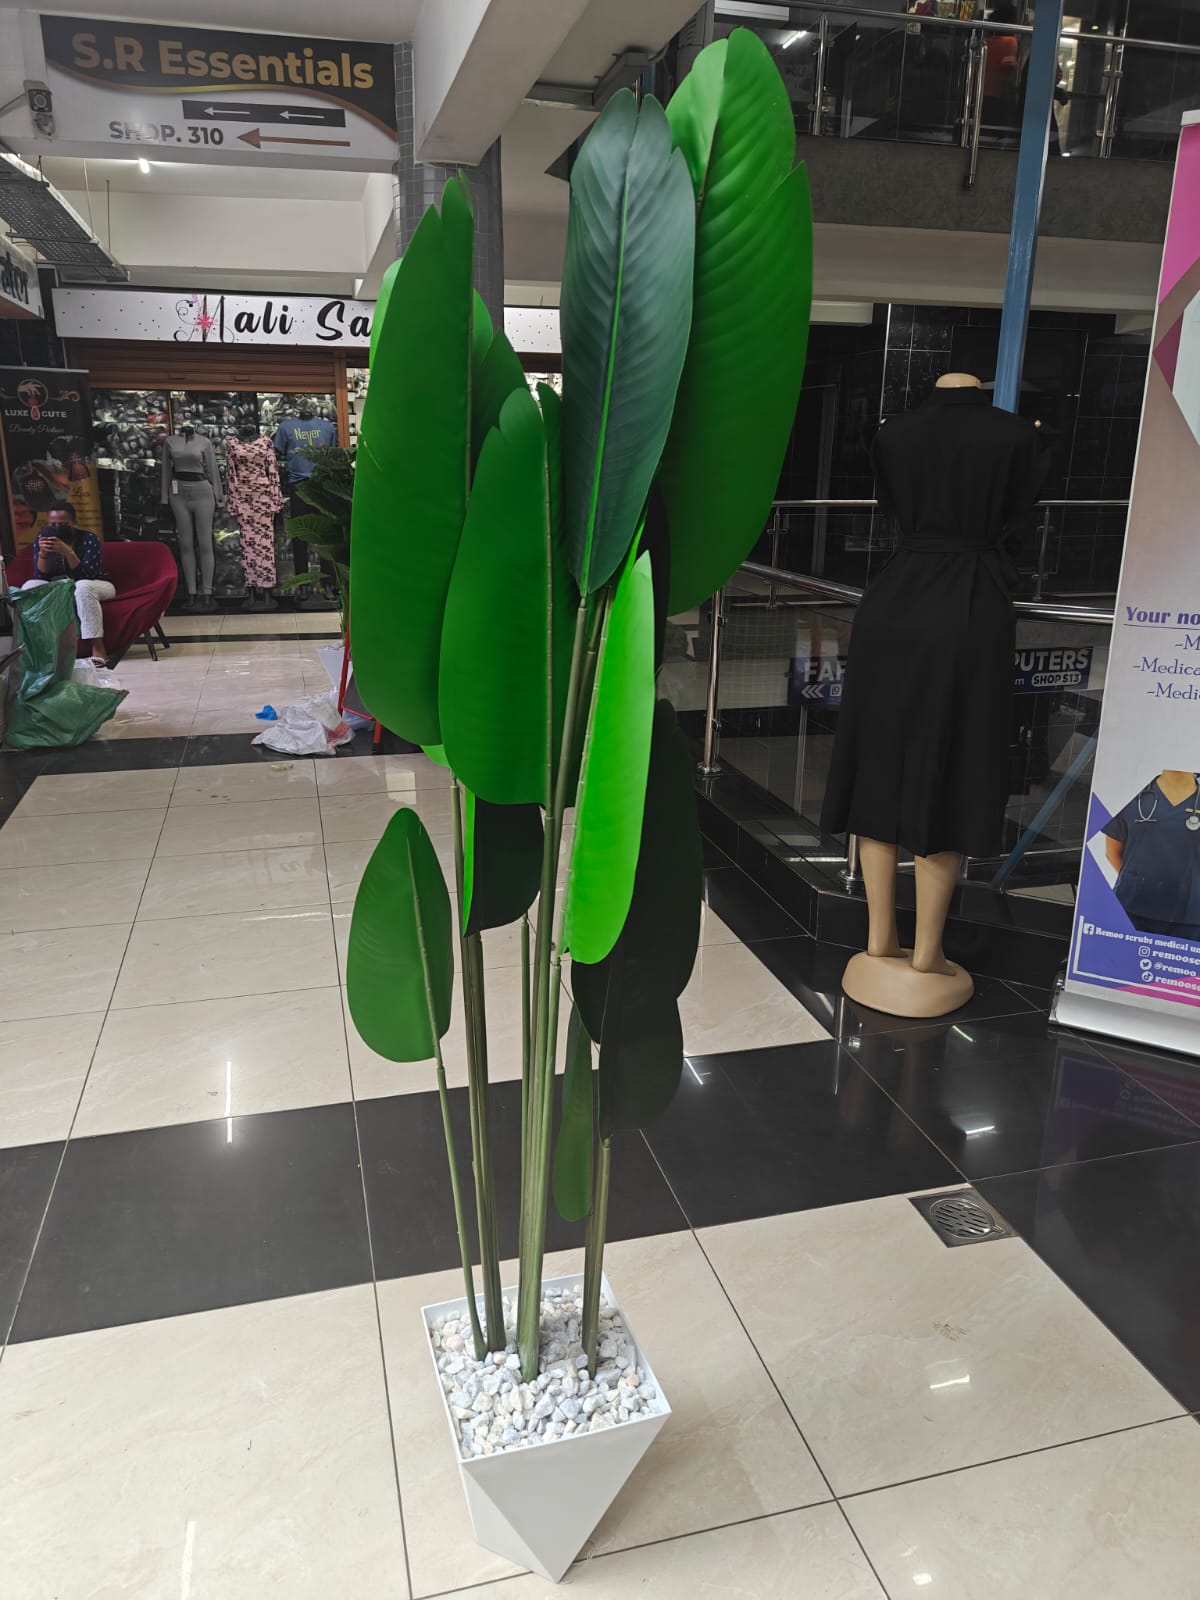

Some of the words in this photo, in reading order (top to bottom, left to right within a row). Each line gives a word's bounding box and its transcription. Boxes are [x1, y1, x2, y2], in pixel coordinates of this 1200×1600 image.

[72, 32, 145, 72] S.R
[158, 39, 374, 89] Essentials
[187, 126, 224, 145] 310
[4, 409, 29, 417] LUXE
[1125, 606, 1171, 624] Your
[1014, 648, 1089, 672] UTERS
[1033, 674, 1061, 685] SHOP
[1147, 682, 1200, 701] -Medi
[1095, 926, 1124, 940] Remoo
[1125, 934, 1153, 945] scrubs
[1154, 939, 1189, 951] medical
[1153, 961, 1197, 977] @remoo
